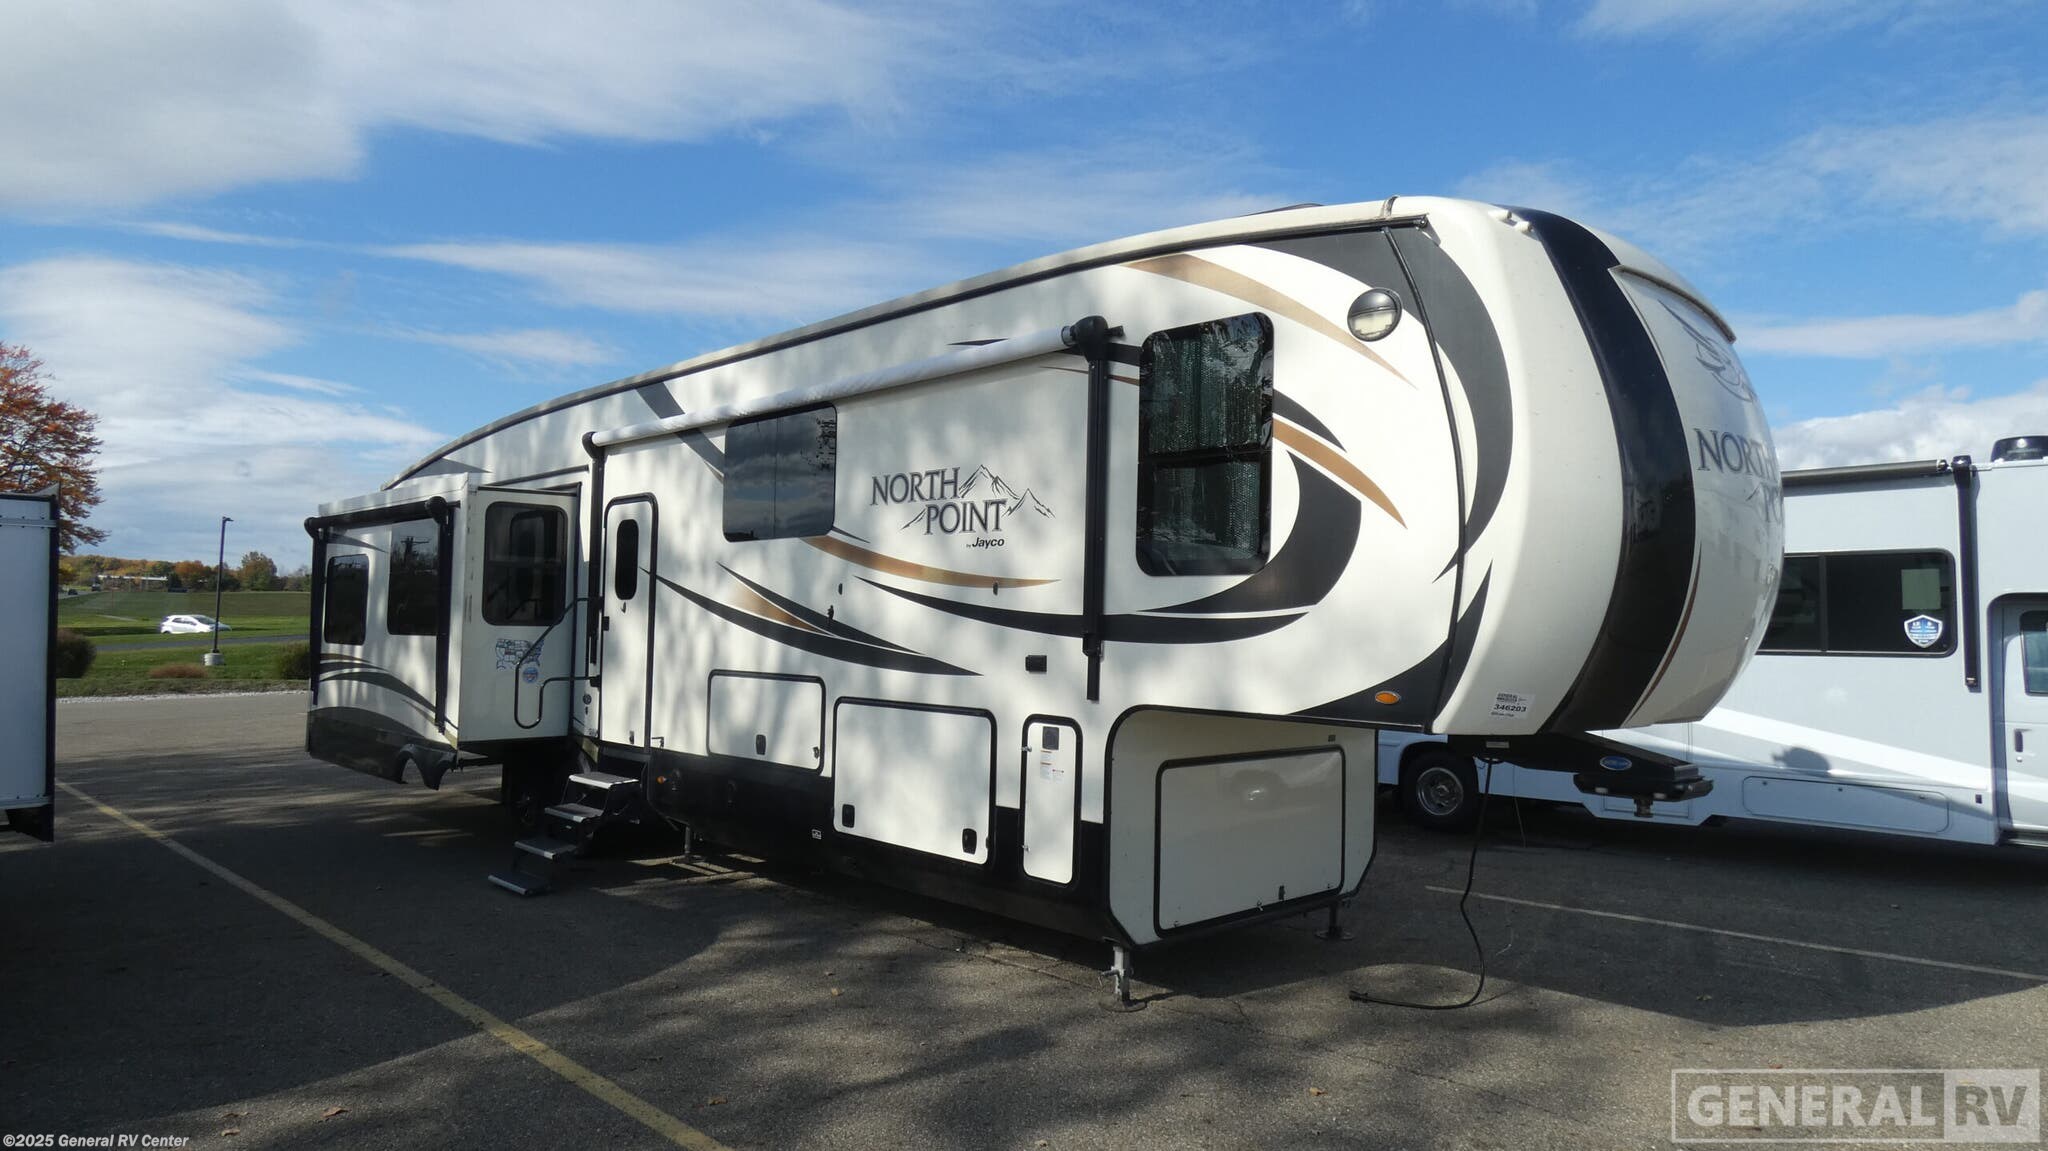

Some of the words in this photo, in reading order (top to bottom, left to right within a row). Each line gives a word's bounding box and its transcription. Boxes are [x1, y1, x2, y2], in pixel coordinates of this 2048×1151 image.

[1694, 428, 1779, 484] NORTH
[870, 466, 961, 506] NORTH
[924, 498, 1008, 535] POINT
[972, 536, 1005, 550] Jayco
[1493, 703, 1527, 713] 346203
